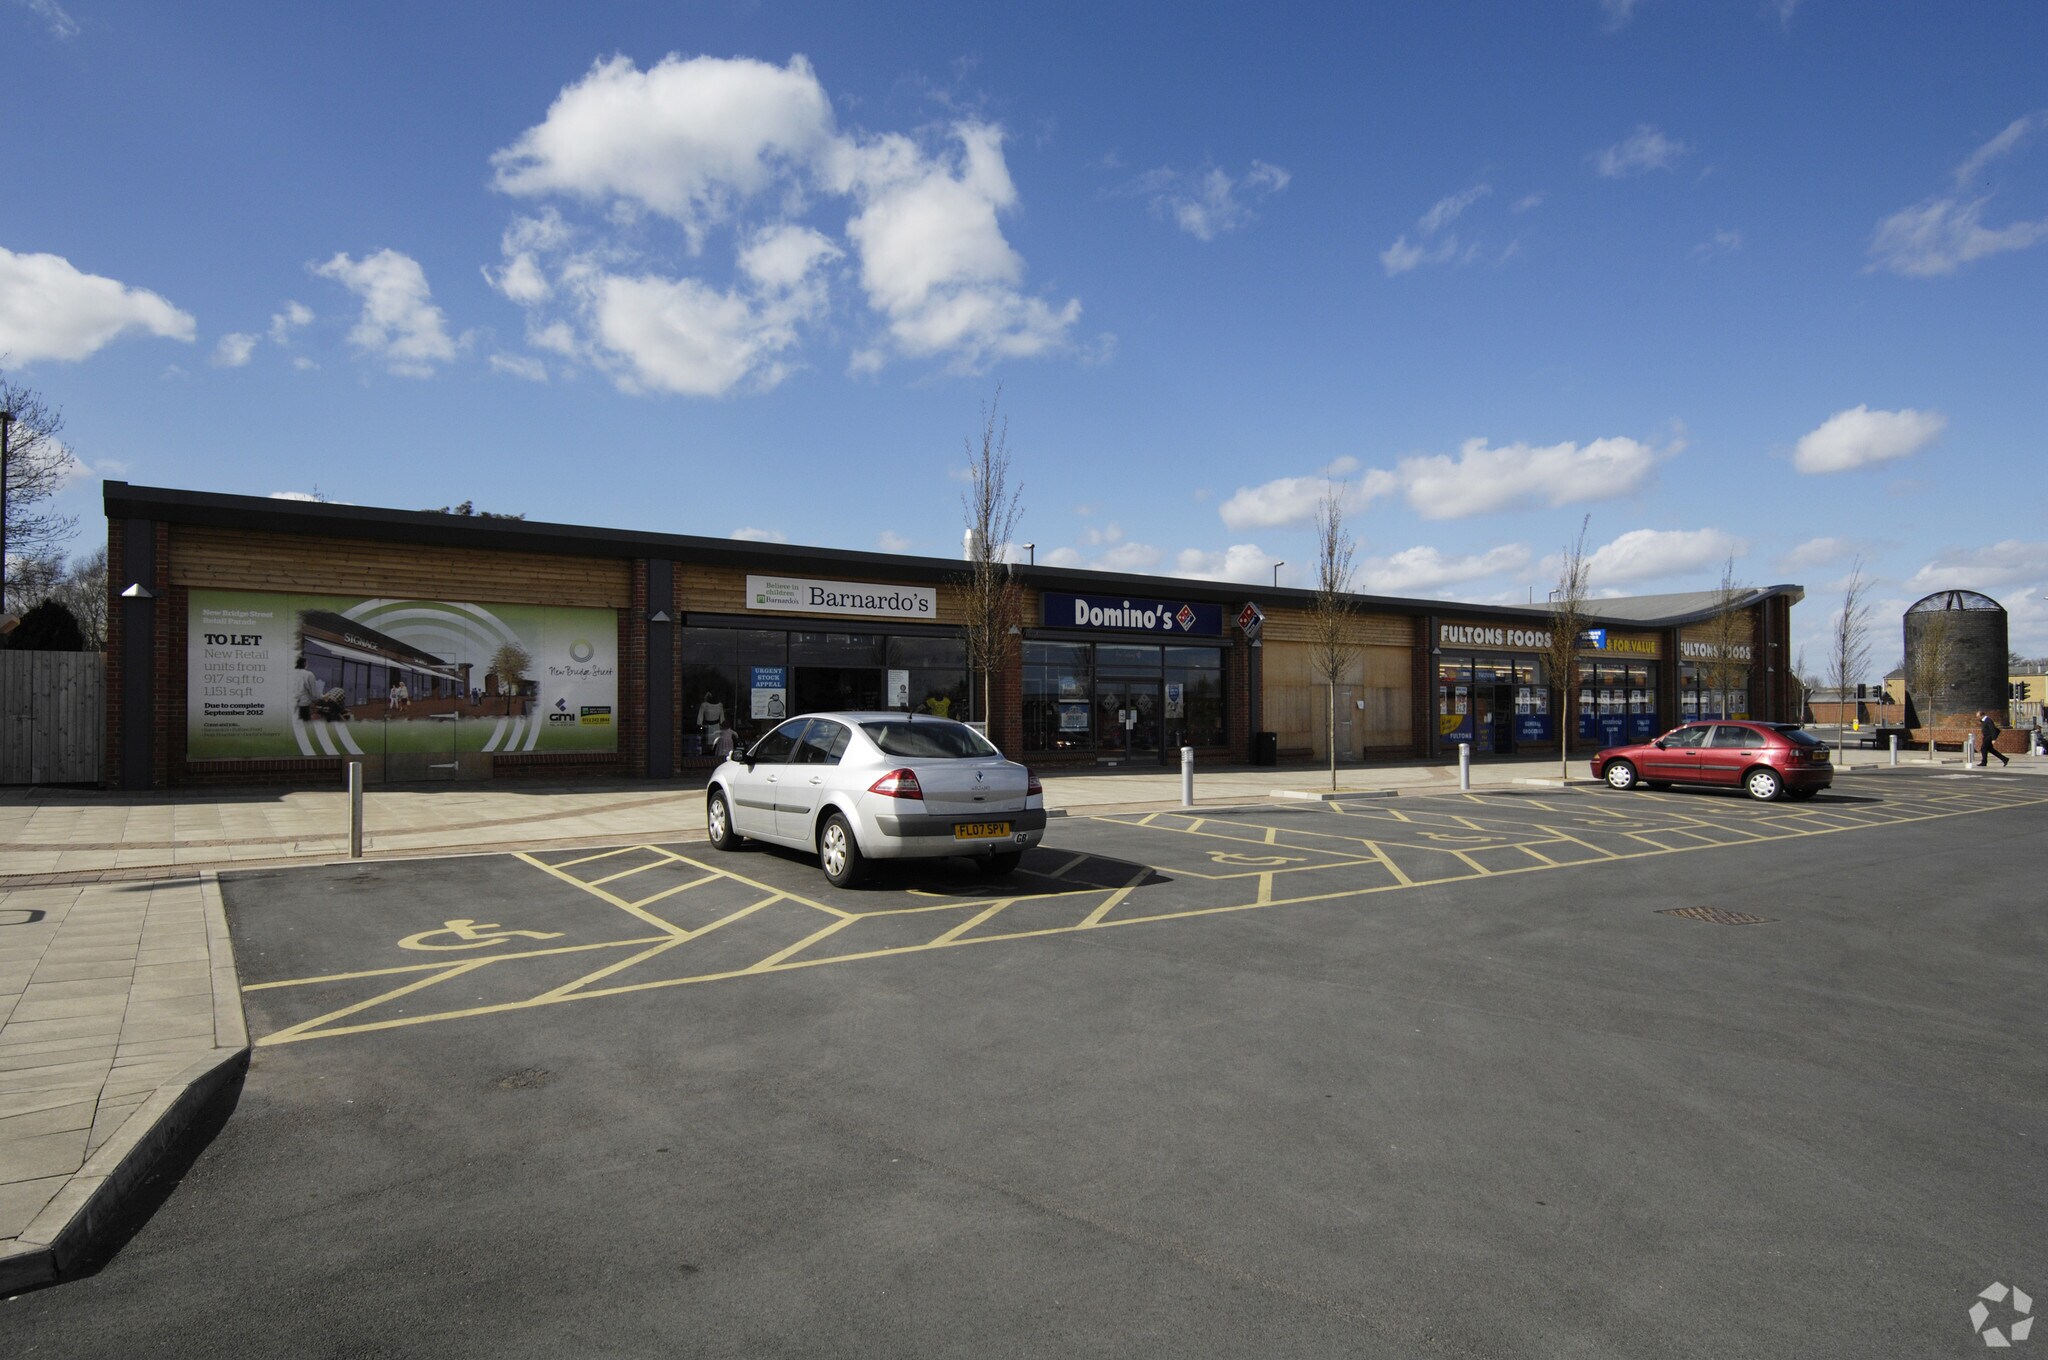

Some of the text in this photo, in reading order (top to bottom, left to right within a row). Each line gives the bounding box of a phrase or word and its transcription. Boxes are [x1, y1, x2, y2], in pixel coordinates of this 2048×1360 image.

[766, 582, 791, 590] Believe
[809, 586, 929, 612] Barnardo's
[202, 608, 221, 616] New
[222, 609, 248, 618] Bridge
[1075, 599, 1173, 630] Domino's
[202, 617, 227, 625] Retail
[204, 633, 262, 646] TO LET
[344, 632, 379, 651] SIGNAGE
[1440, 625, 1552, 648] FULTONS FOODS
[1613, 639, 1629, 652] FOR
[1631, 640, 1656, 654] VALUE
[204, 649, 269, 660] New Retail
[1721, 645, 1751, 660] OODS
[204, 661, 266, 671] units from
[204, 673, 225, 684] 917
[252, 675, 264, 684] to
[203, 686, 227, 697] 1,151
[229, 702, 265, 710] complete
[204, 709, 245, 717] September
[960, 823, 1004, 836] FL07 SPV
[1016, 833, 1027, 843] GB
